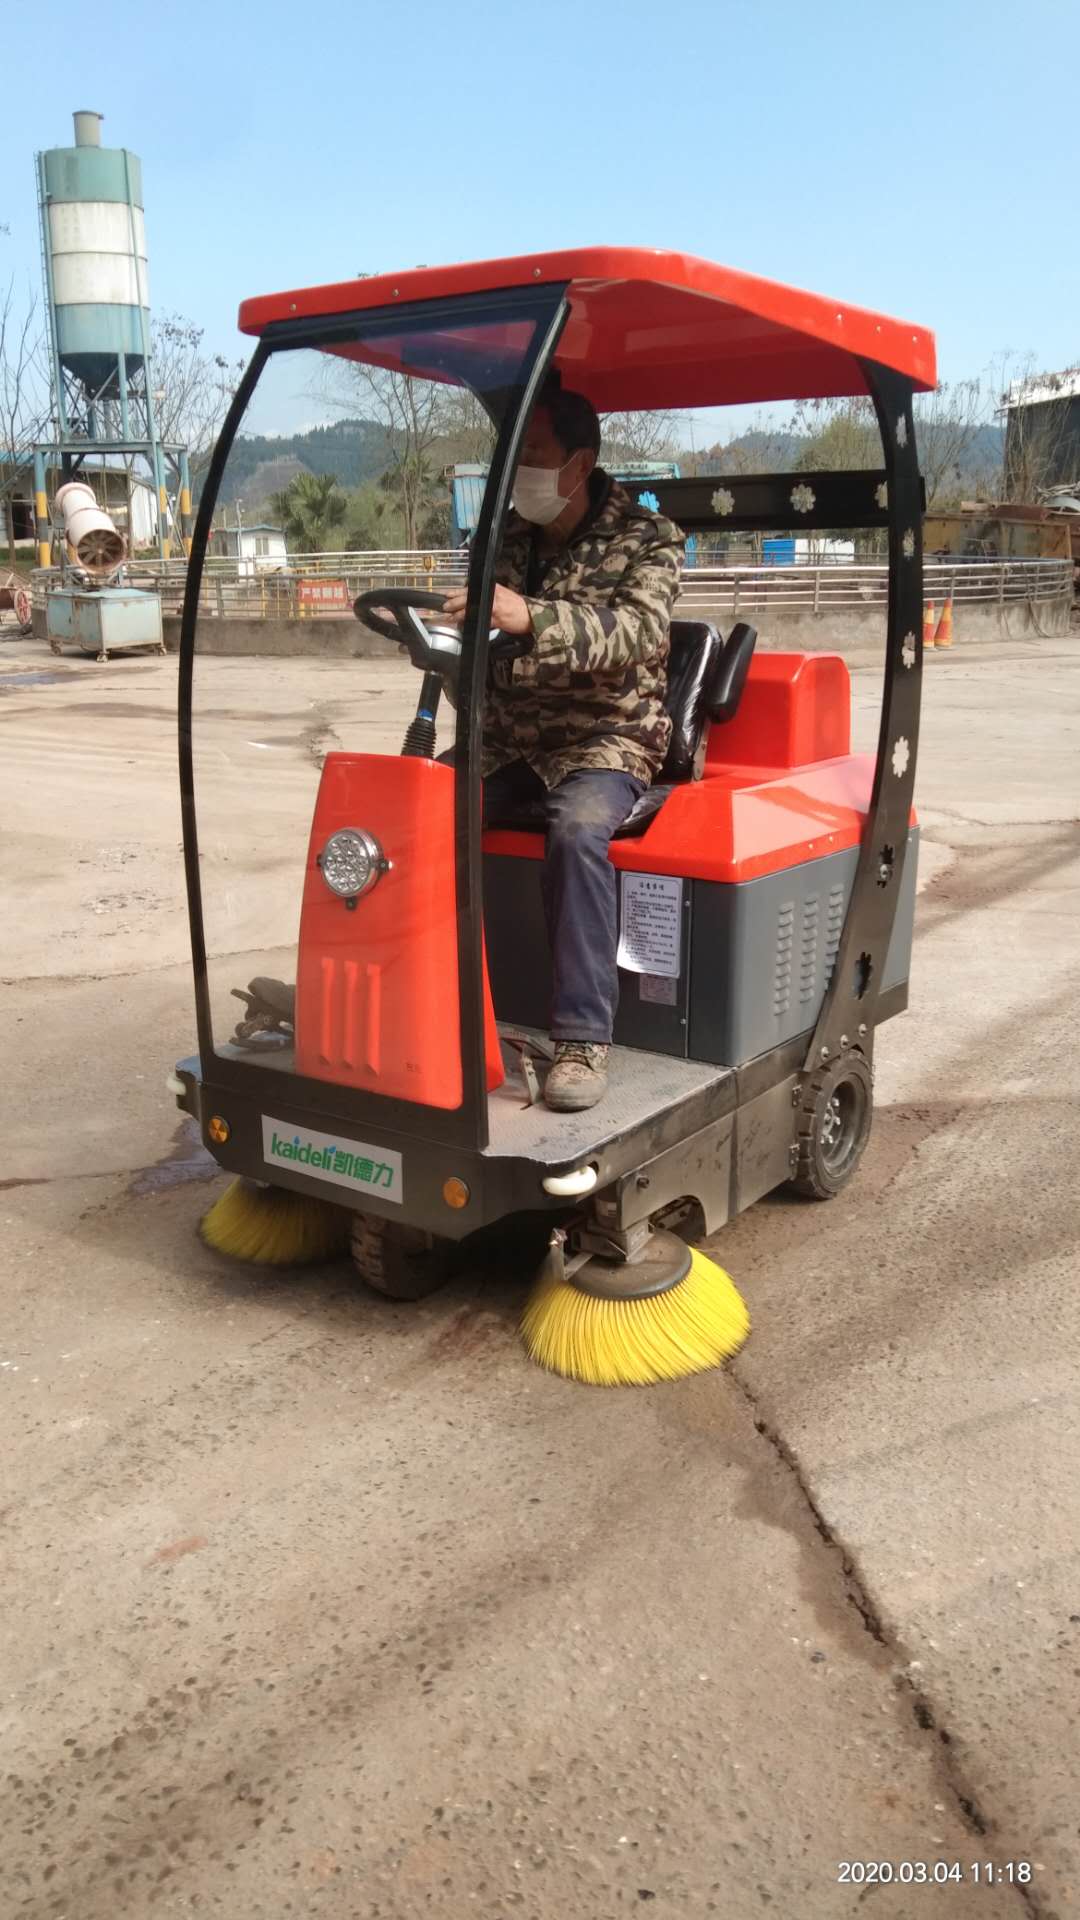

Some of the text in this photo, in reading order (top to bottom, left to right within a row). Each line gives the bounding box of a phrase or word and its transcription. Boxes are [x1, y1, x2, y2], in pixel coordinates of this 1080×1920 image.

[271, 1132, 394, 1188] kaideli 凯德力
